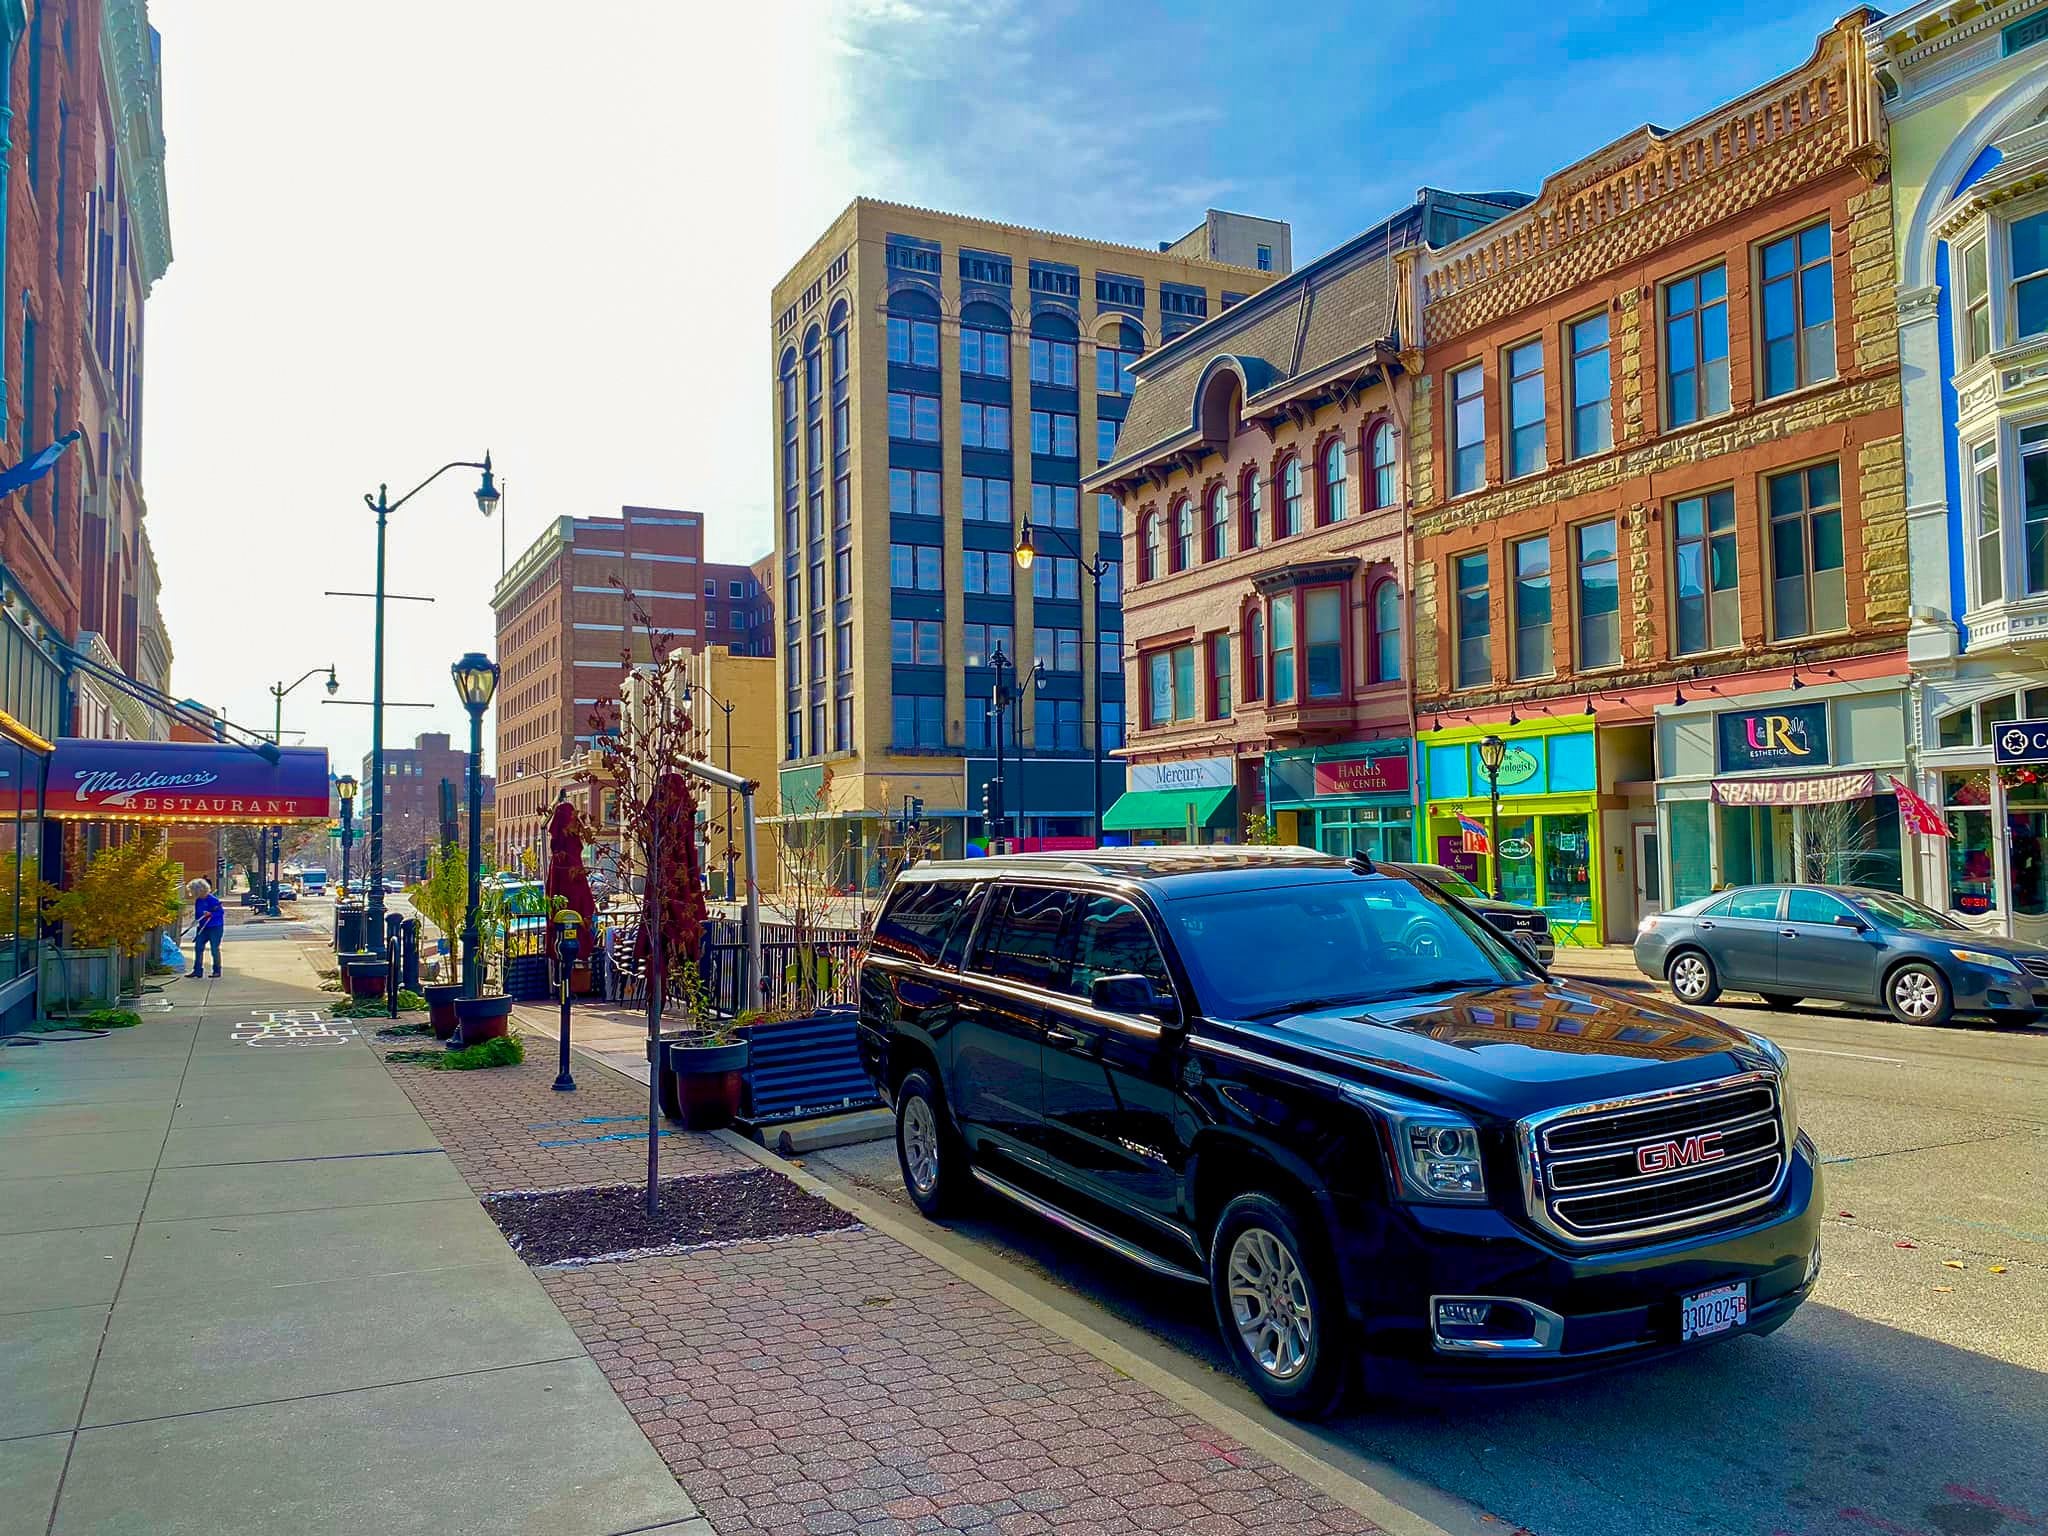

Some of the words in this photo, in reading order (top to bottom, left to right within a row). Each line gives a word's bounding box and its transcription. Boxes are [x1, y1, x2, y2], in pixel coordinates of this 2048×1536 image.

[2032, 732, 2048, 749] C
[1750, 748, 1788, 758] ESTHETICS
[74, 769, 218, 805] Maldaner's
[1334, 781, 1350, 790] LAW
[1353, 778, 1387, 789] CENTER
[1718, 782, 1777, 802] GRAND
[123, 798, 297, 813] RESTAURANT
[1960, 897, 1988, 907] OPEN
[1638, 1130, 1725, 1173] GMC
